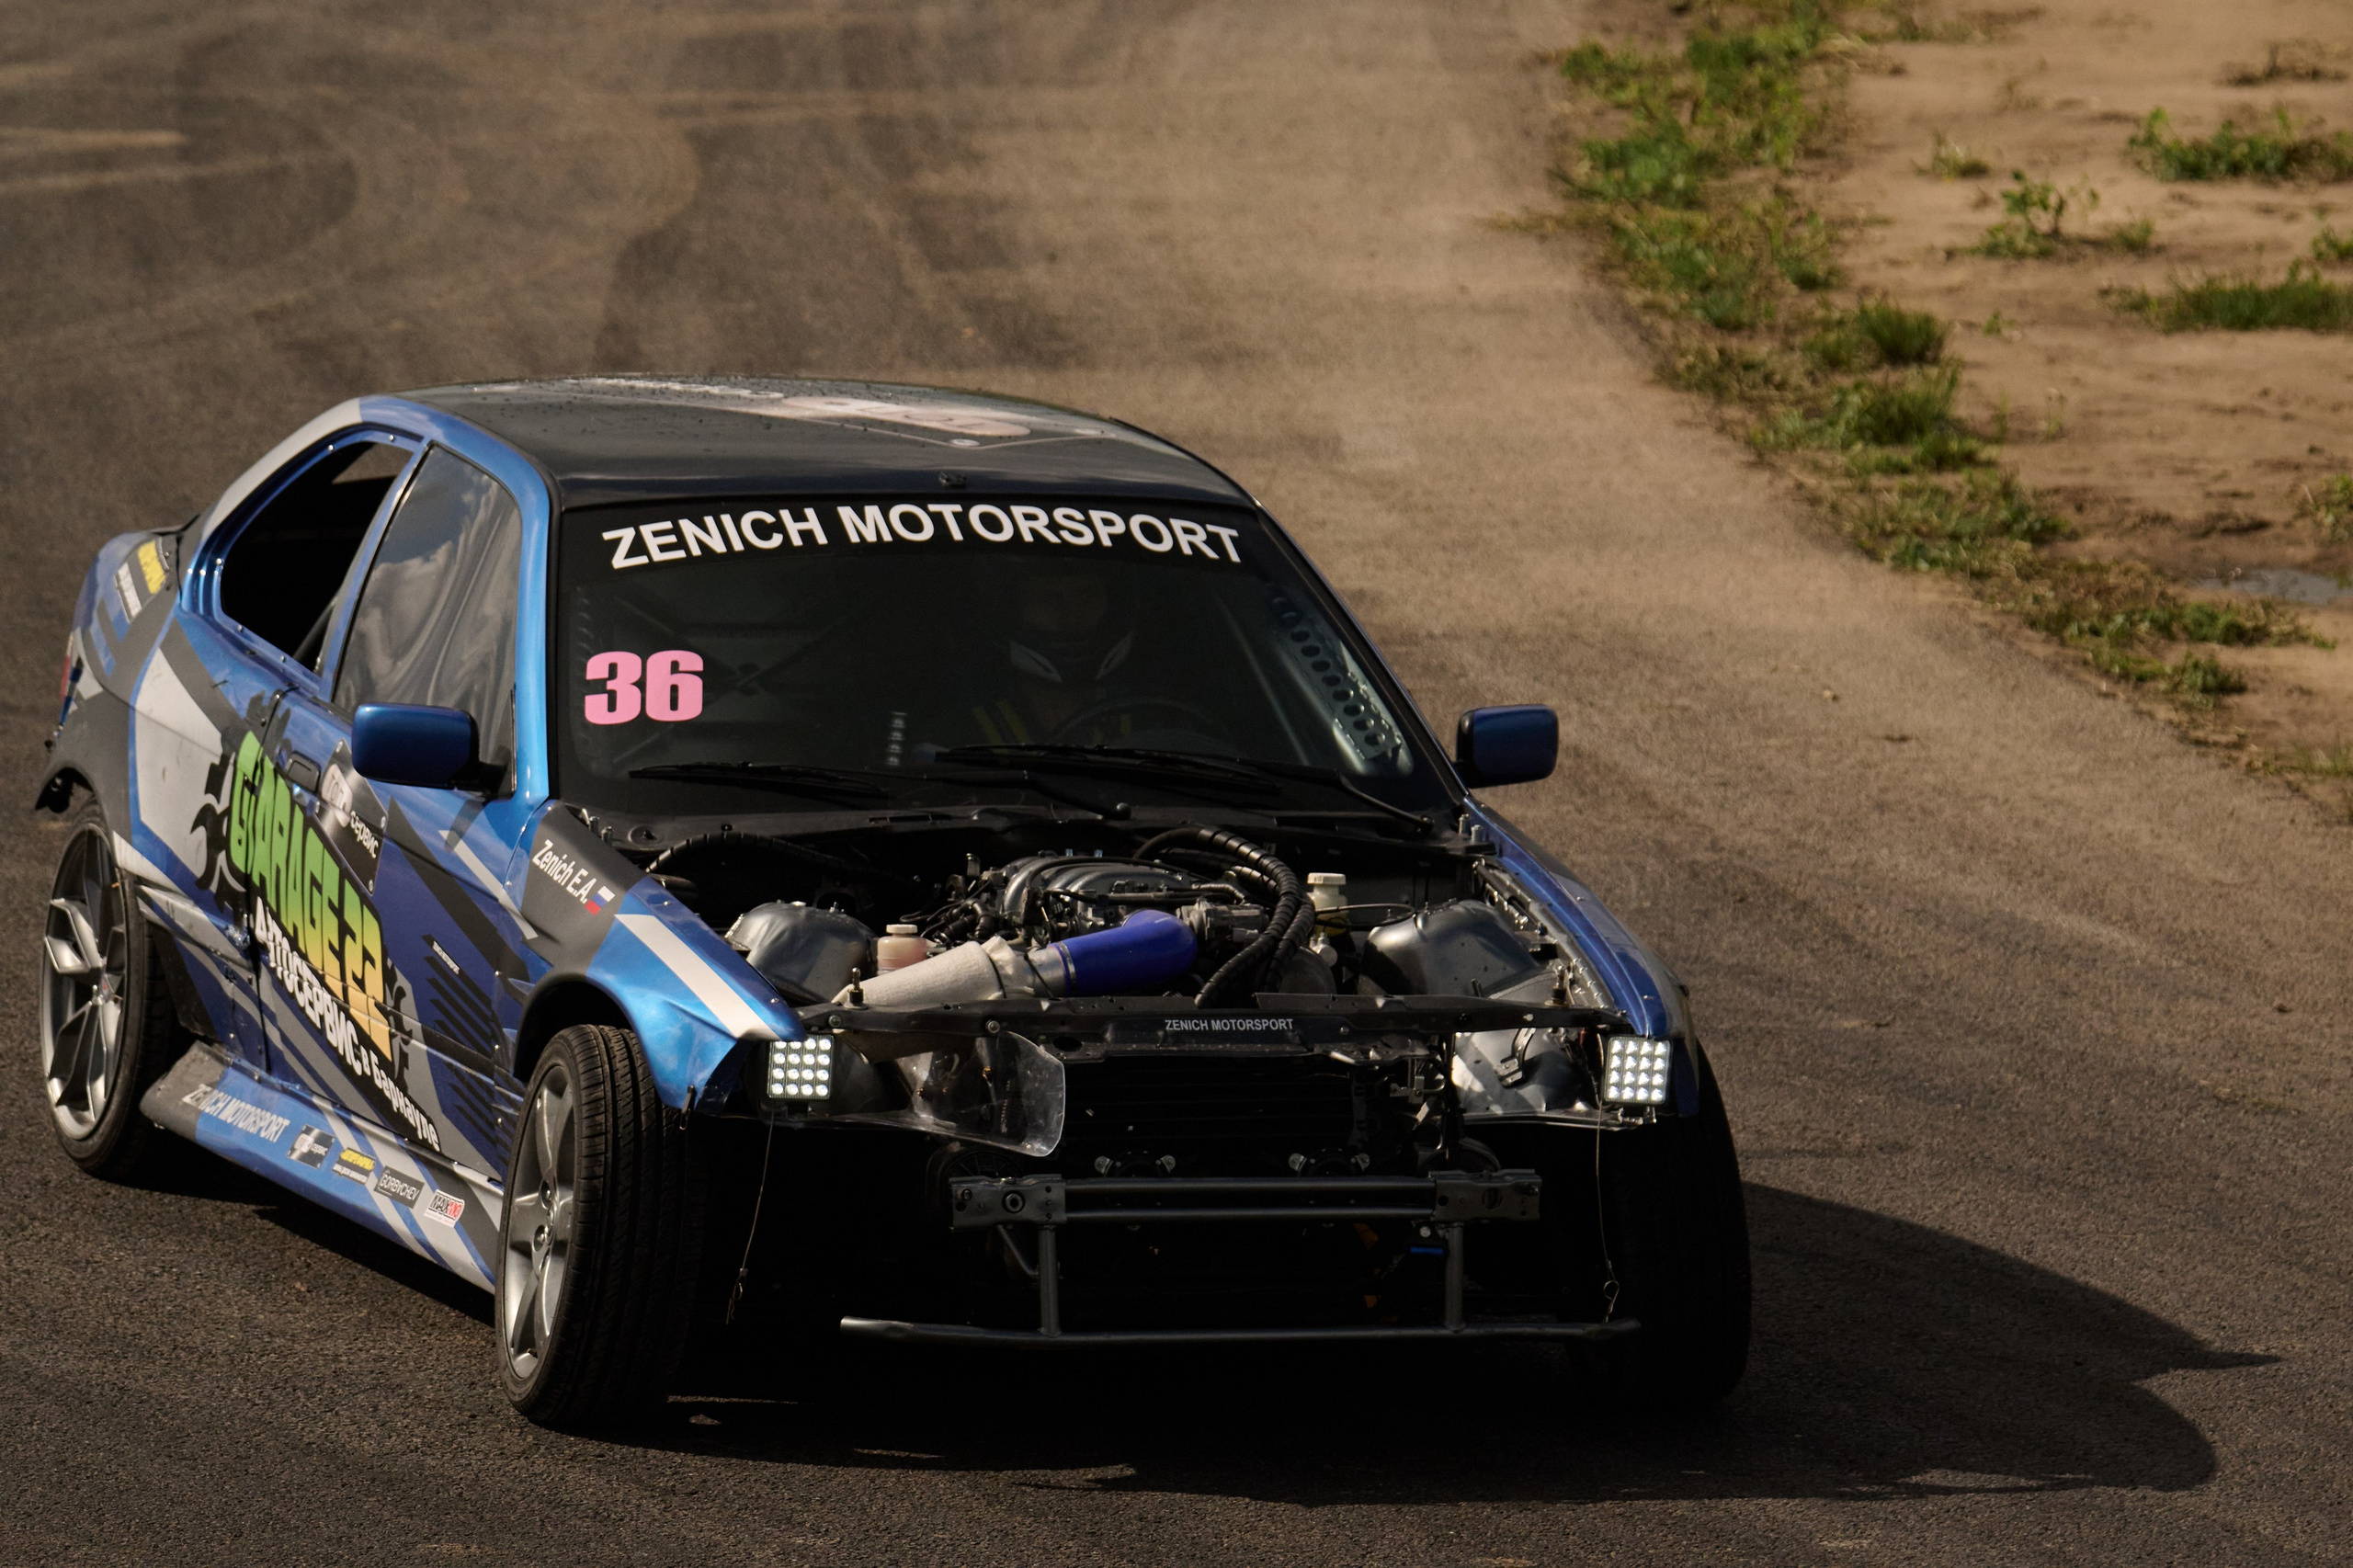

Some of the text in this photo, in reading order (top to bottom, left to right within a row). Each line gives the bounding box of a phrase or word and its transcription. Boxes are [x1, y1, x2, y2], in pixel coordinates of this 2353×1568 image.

[602, 502, 1241, 569] ZENICH MOTORSPORT
[585, 650, 704, 725] 36
[230, 731, 345, 1004] GARAGE
[532, 838, 597, 904] Zenich E.A.
[1165, 1018, 1293, 1030] ZENICH MOTORSPORT
[359, 1044, 371, 1077] в
[369, 1050, 440, 1153] Барнауле
